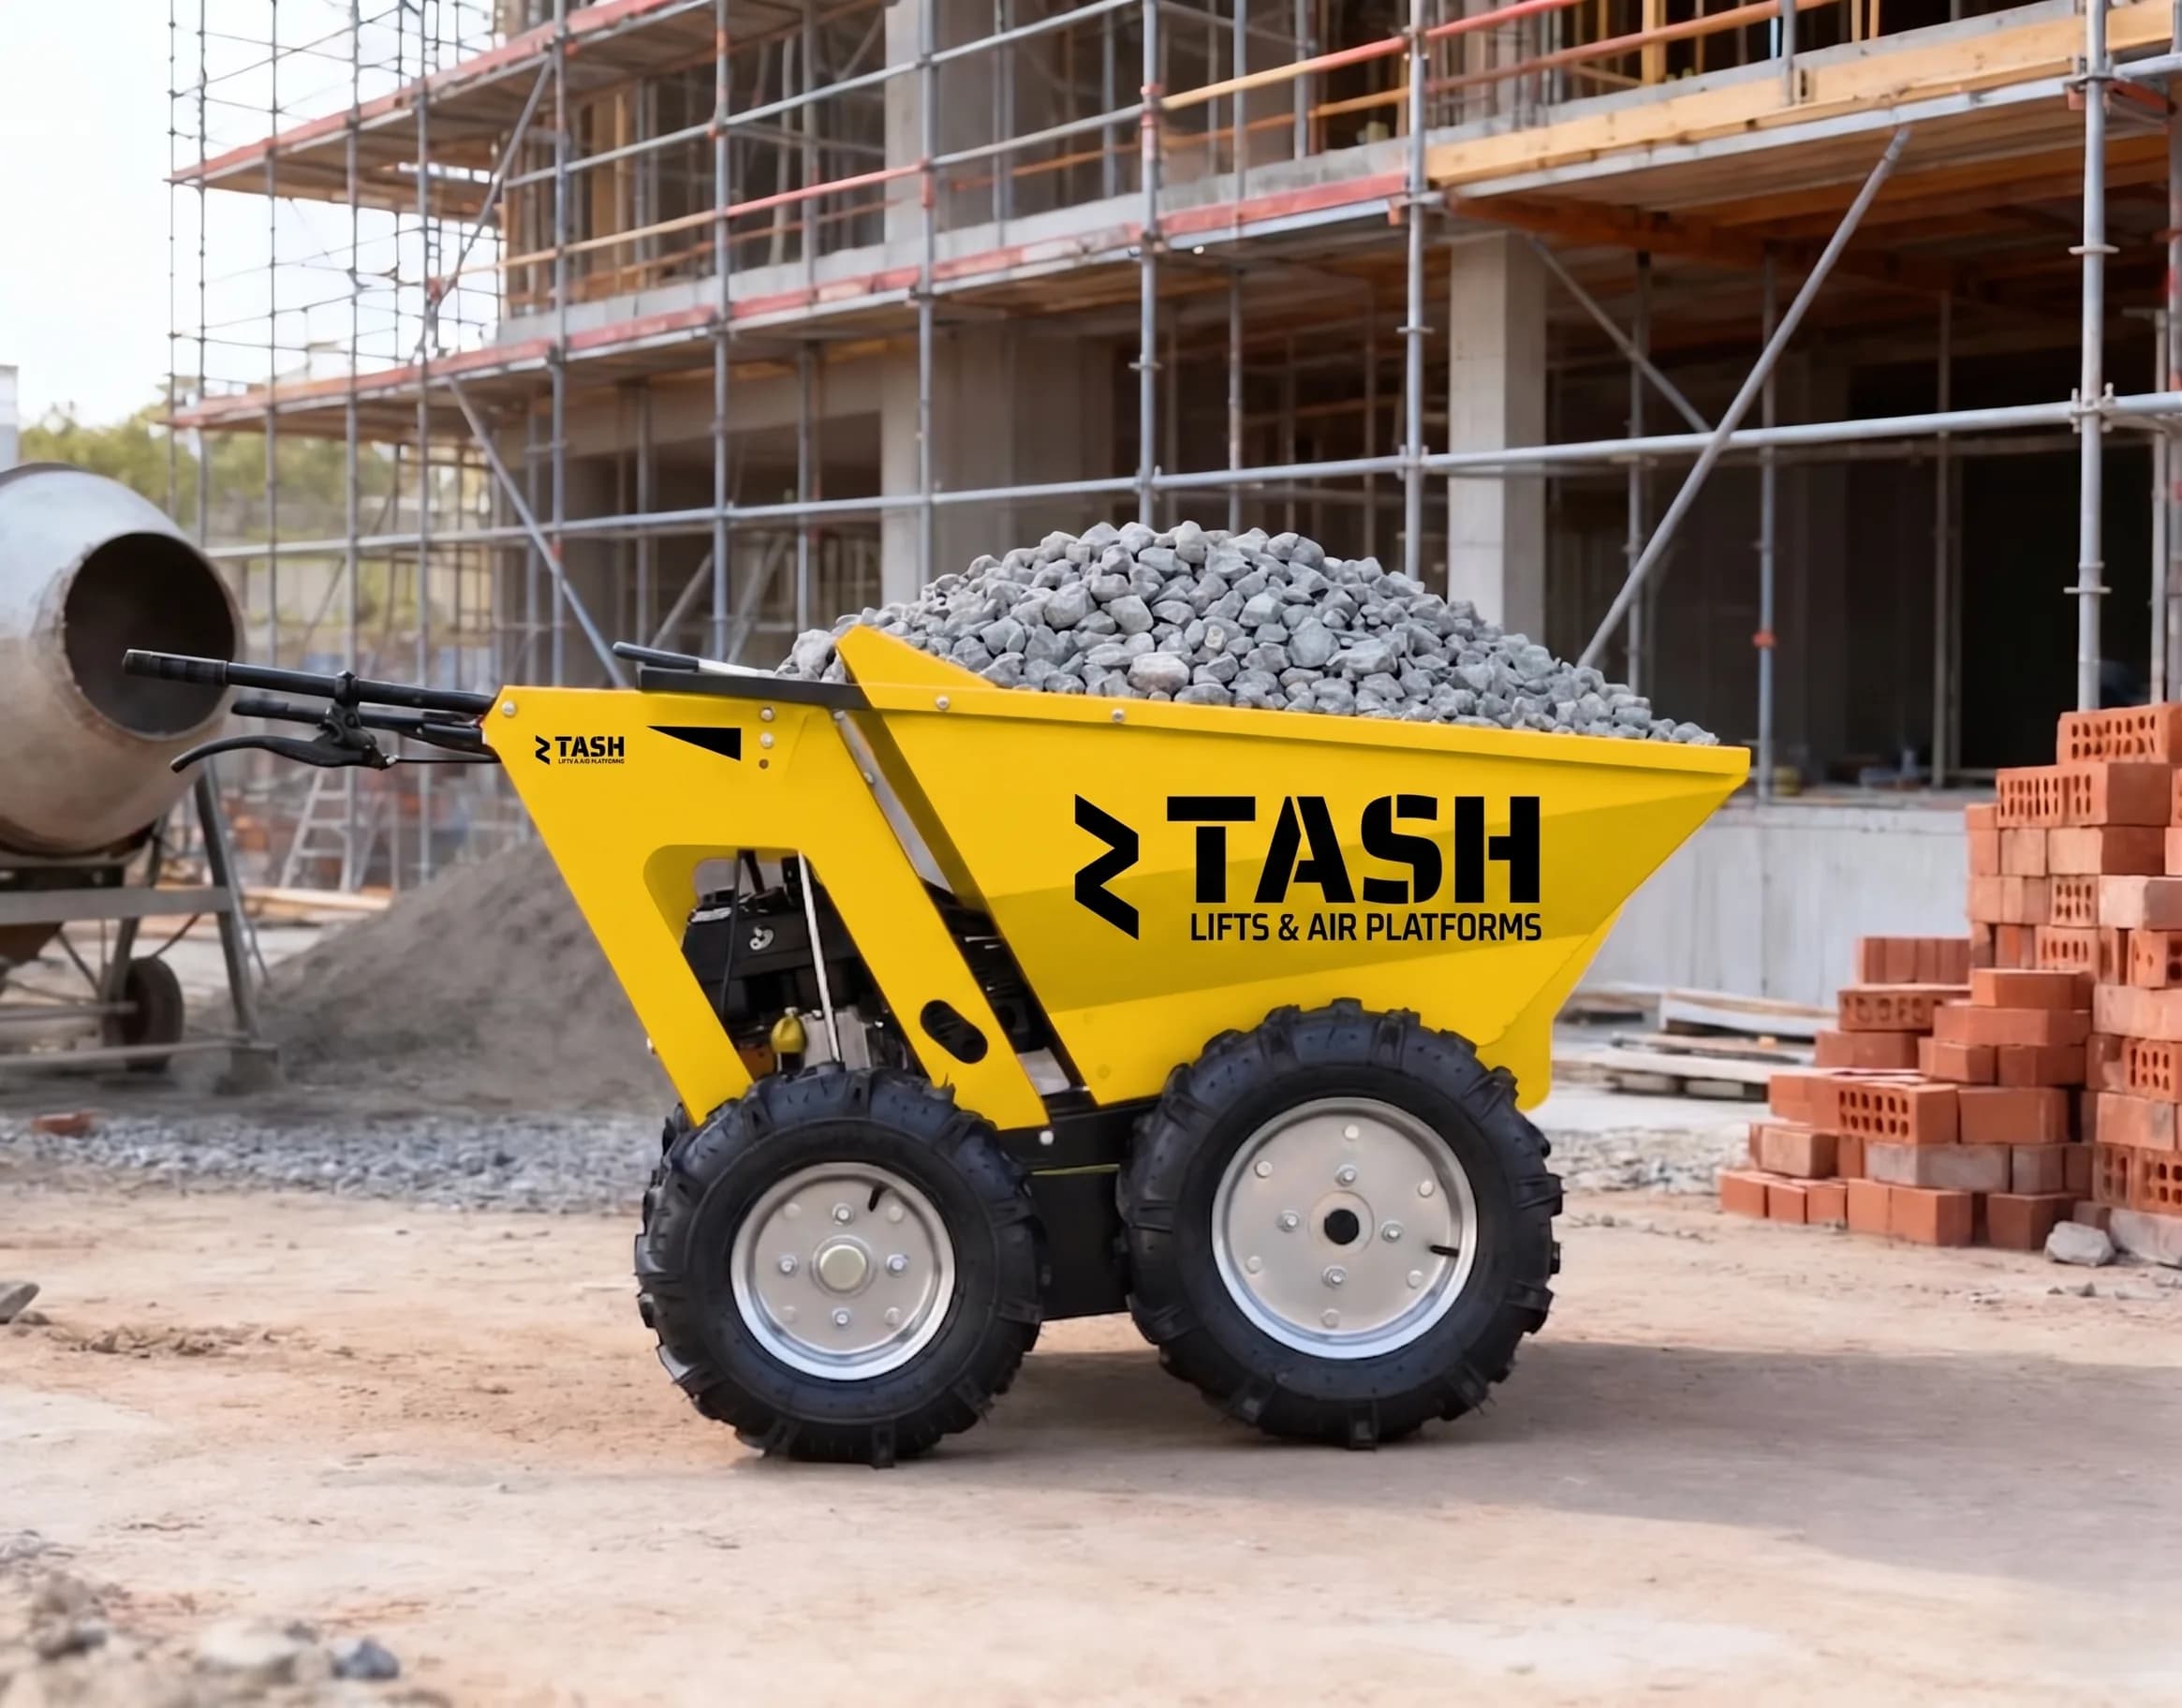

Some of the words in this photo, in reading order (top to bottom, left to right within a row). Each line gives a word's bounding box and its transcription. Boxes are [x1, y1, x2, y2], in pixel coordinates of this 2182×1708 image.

[554, 736, 625, 758] TASH
[1167, 795, 1541, 904] TASH
[1191, 913, 1270, 941] LIFTS
[1277, 913, 1300, 941] &
[1307, 913, 1357, 941] AIR
[1366, 913, 1542, 941] PLATFORMS
